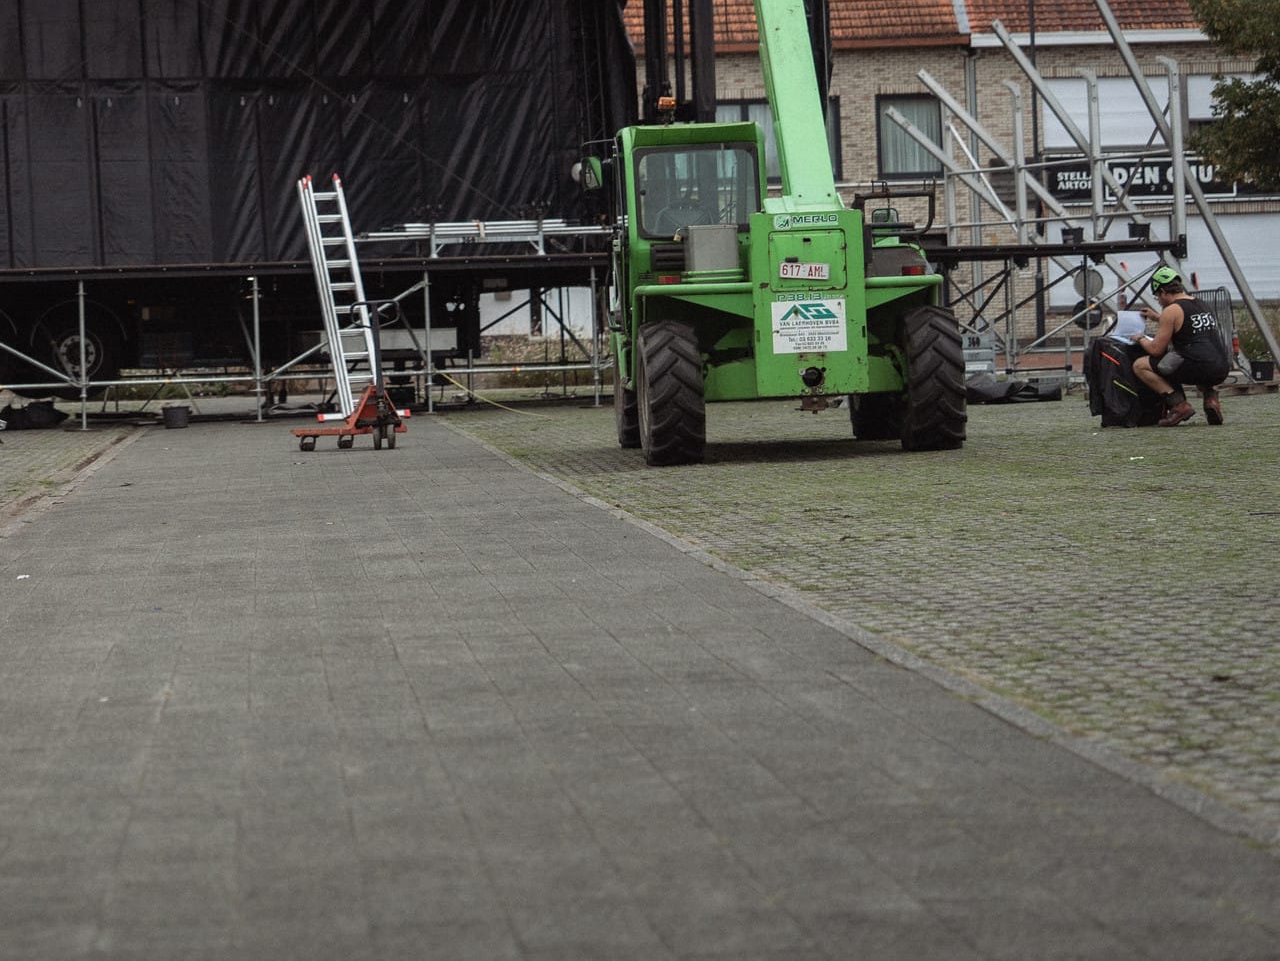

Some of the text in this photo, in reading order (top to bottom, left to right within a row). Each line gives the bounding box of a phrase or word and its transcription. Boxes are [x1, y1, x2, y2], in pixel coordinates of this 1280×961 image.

[1113, 166, 1160, 184] DEN
[792, 215, 838, 224] MERLO
[782, 264, 827, 278] 617 AML
